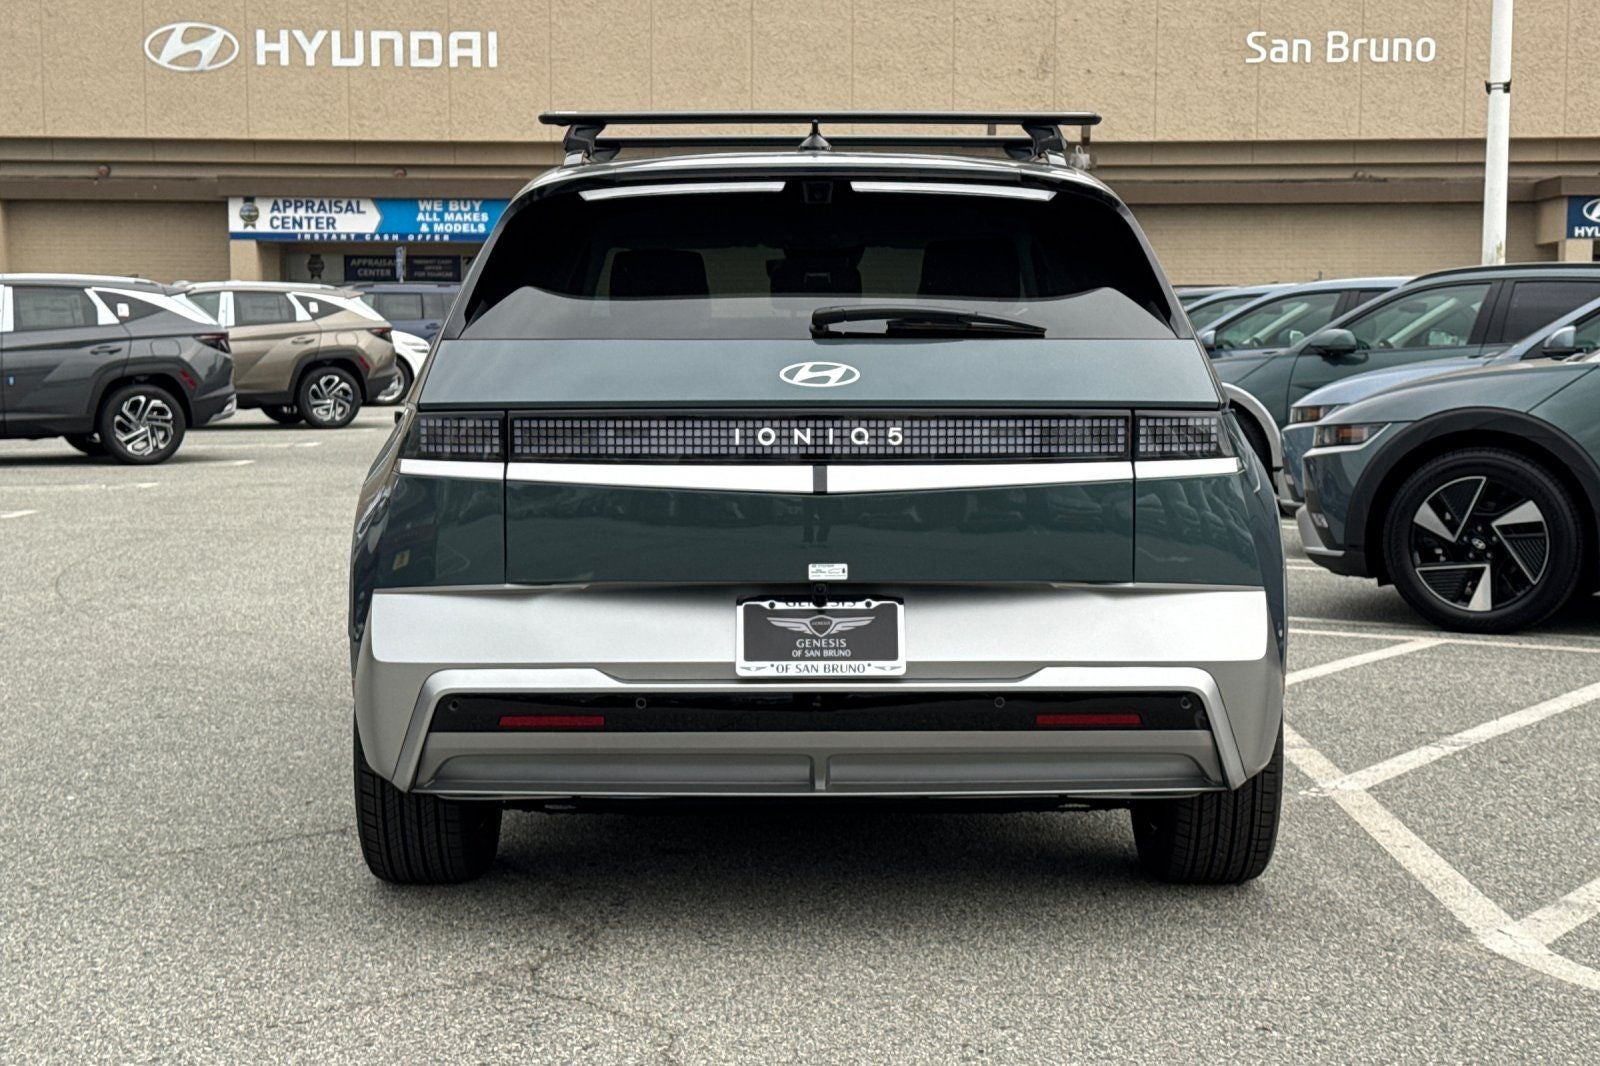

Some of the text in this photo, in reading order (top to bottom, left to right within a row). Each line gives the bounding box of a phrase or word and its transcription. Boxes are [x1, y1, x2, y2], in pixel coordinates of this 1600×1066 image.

[256, 29, 498, 68] HYUNDAI
[1245, 31, 1436, 63] San Bruno
[270, 199, 366, 214] APPRAISAL
[418, 199, 483, 212] WE BUY
[416, 212, 489, 222] ALL MAKES
[269, 216, 337, 230] CENTER
[420, 223, 486, 233] & MODELS
[297, 233, 450, 241] INSTANT CASH OFFER
[350, 258, 395, 267] APPRAISA
[735, 427, 903, 445] IONIQ 5
[796, 638, 847, 648] GENESIS
[791, 649, 852, 658] OF SAN BRUNO
[775, 663, 866, 674] OF SAN BRUNO
